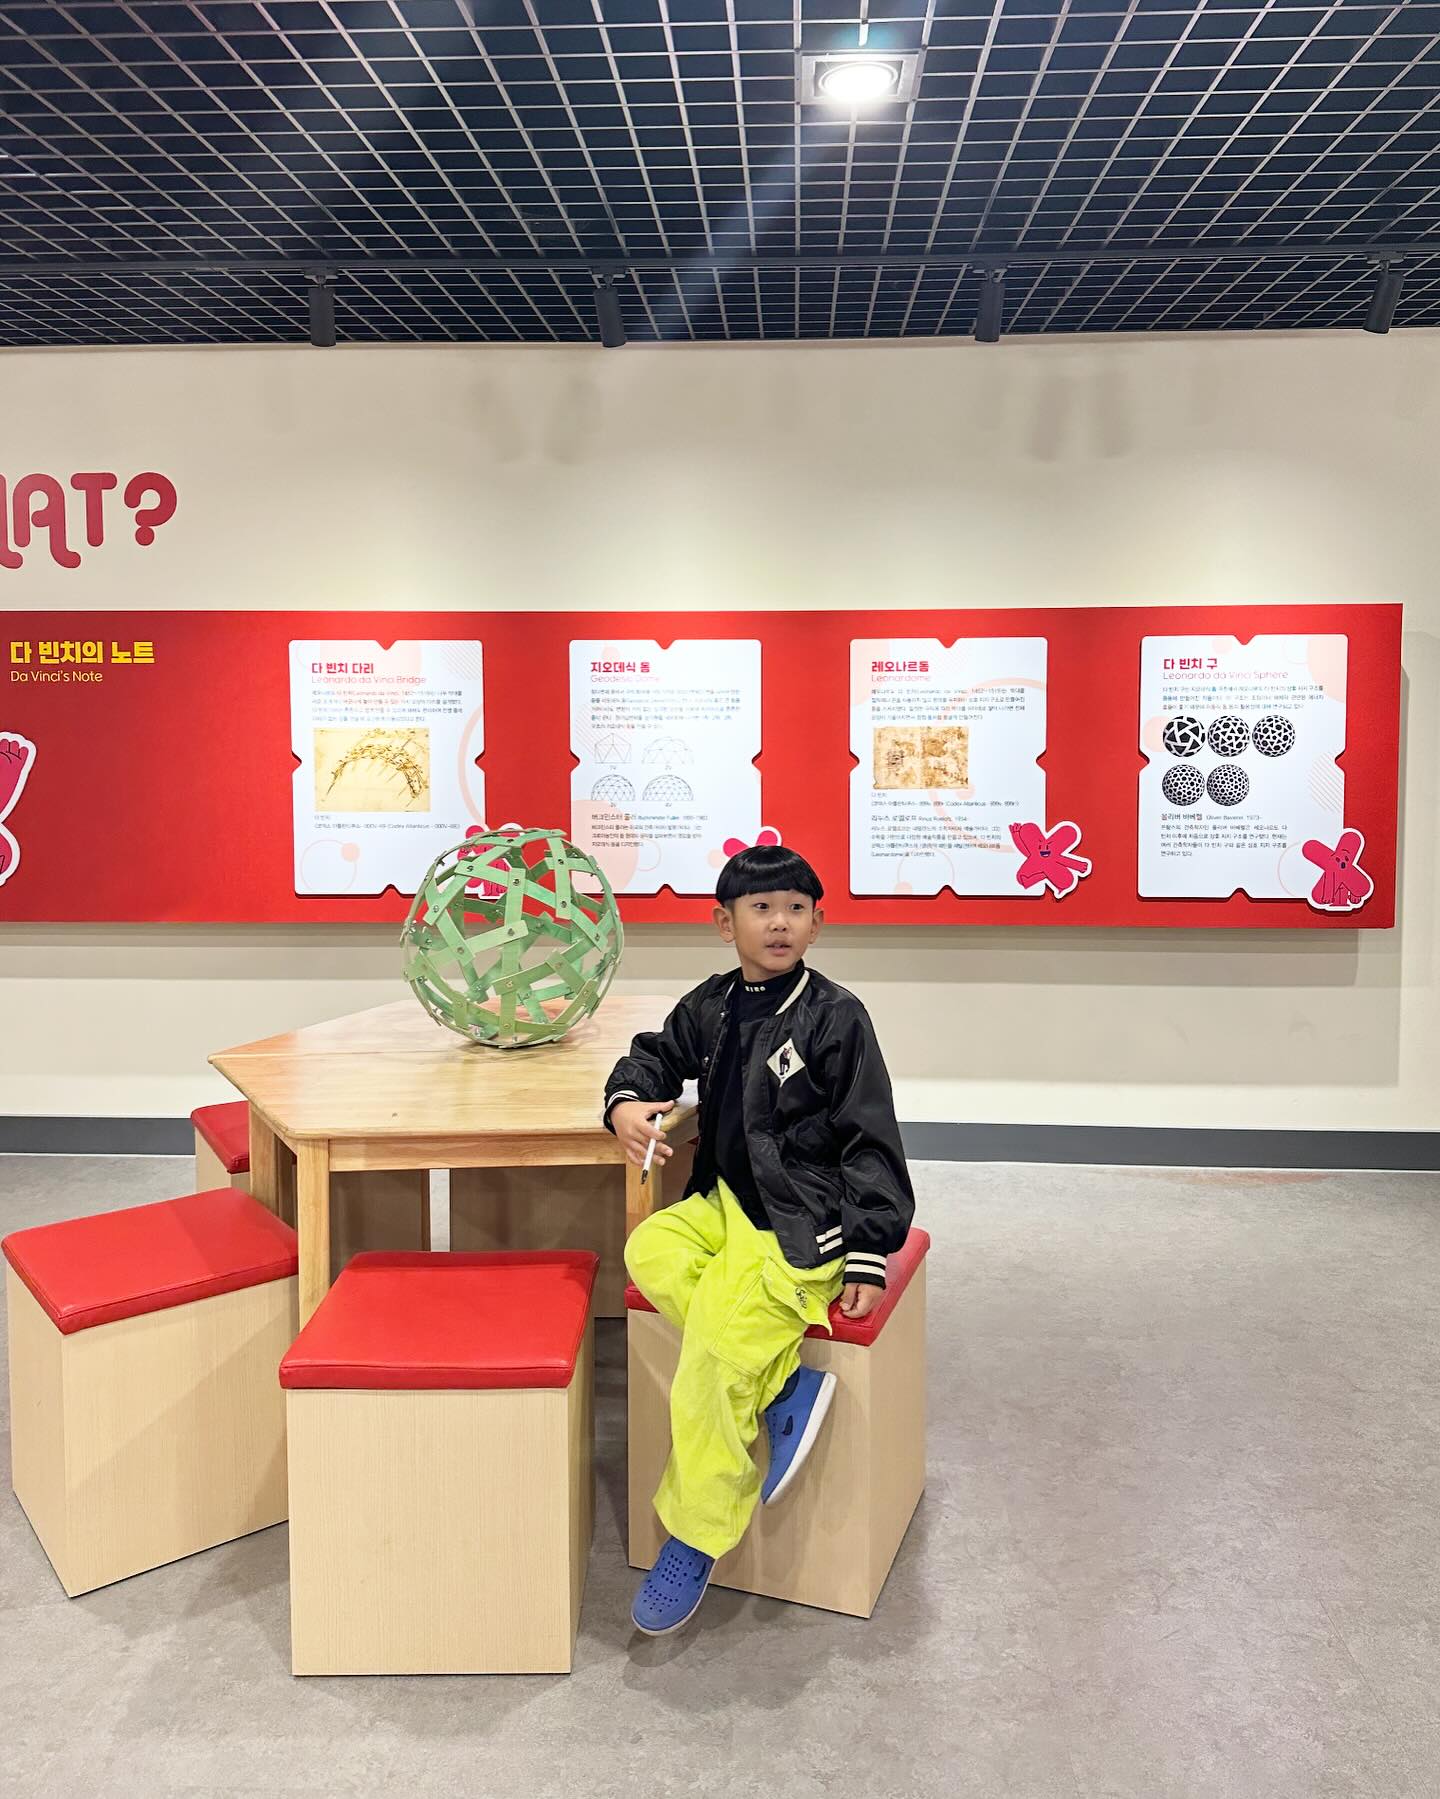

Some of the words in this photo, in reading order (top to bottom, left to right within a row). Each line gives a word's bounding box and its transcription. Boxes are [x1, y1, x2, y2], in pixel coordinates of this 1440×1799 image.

[10, 641, 32, 663] 다
[38, 640, 104, 664] 빈치의
[111, 641, 155, 664] 노트
[311, 662, 323, 674] 다
[326, 662, 348, 674] 빈치
[352, 662, 374, 674] 다리
[590, 661, 636, 673] 지오데식
[640, 661, 651, 673] 돔
[871, 660, 930, 673] 레오나르돔
[1163, 658, 1176, 670] 다
[1179, 658, 1203, 670] 빈치
[1206, 658, 1218, 670] 구
[10, 670, 28, 682] Da
[30, 670, 70, 682] Vinci's
[72, 670, 103, 682] Note
[311, 675, 356, 684] Leonardo
[1163, 671, 1211, 680] Leonardo
[1213, 671, 1227, 680] da
[1253, 670, 1289, 681] Sphere
